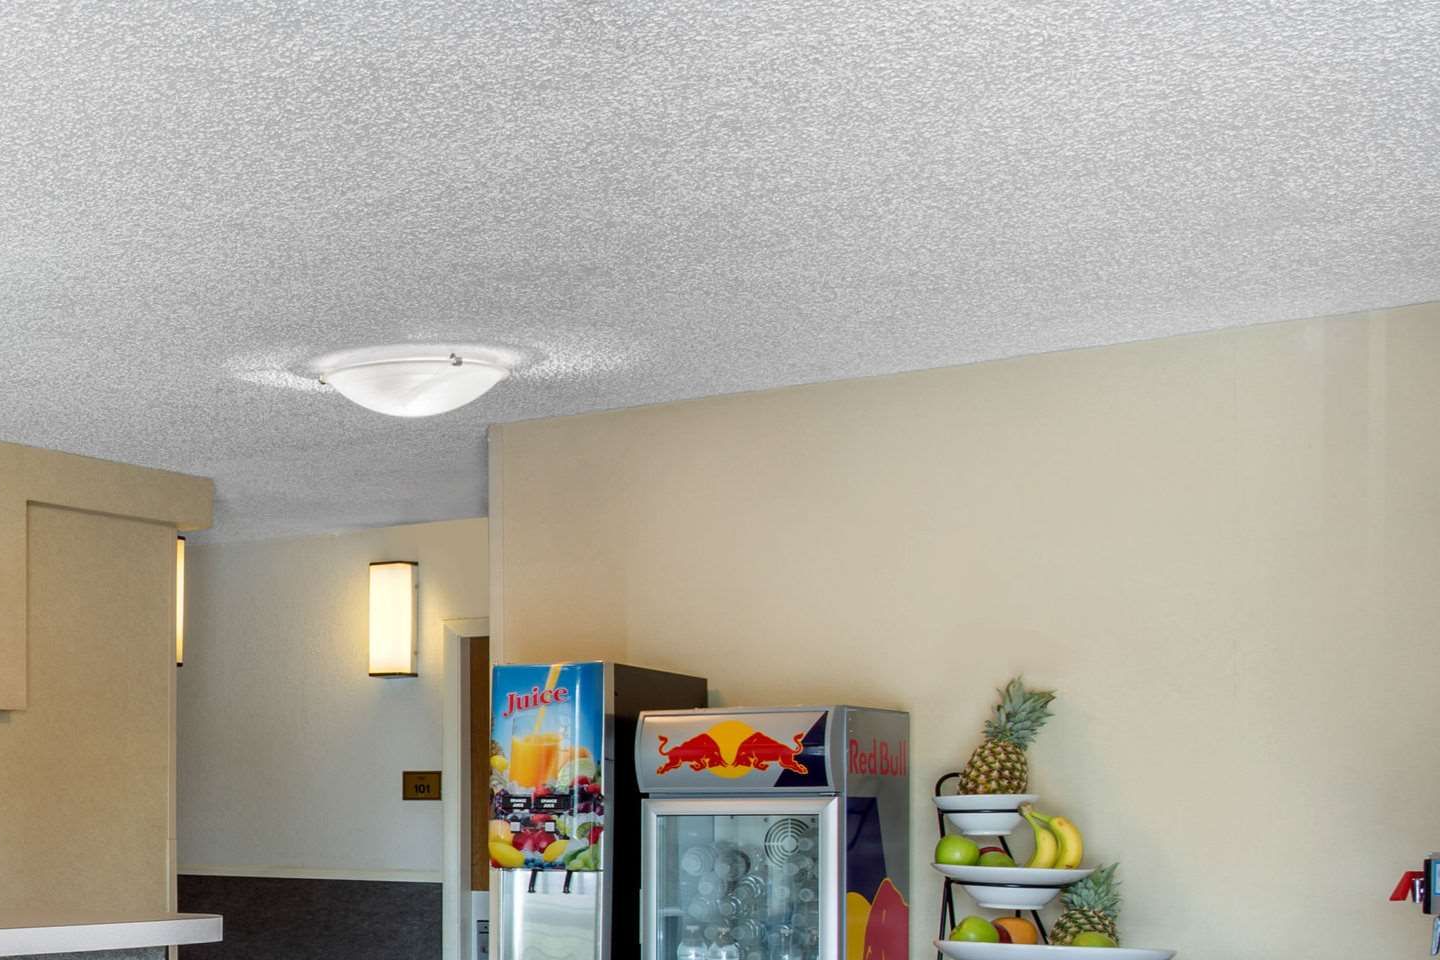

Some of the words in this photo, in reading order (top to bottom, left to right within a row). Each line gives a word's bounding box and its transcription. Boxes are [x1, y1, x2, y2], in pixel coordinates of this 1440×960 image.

[502, 686, 569, 718] Juice
[848, 736, 877, 775] Red
[880, 740, 907, 777] Bull
[414, 783, 432, 794] 101
